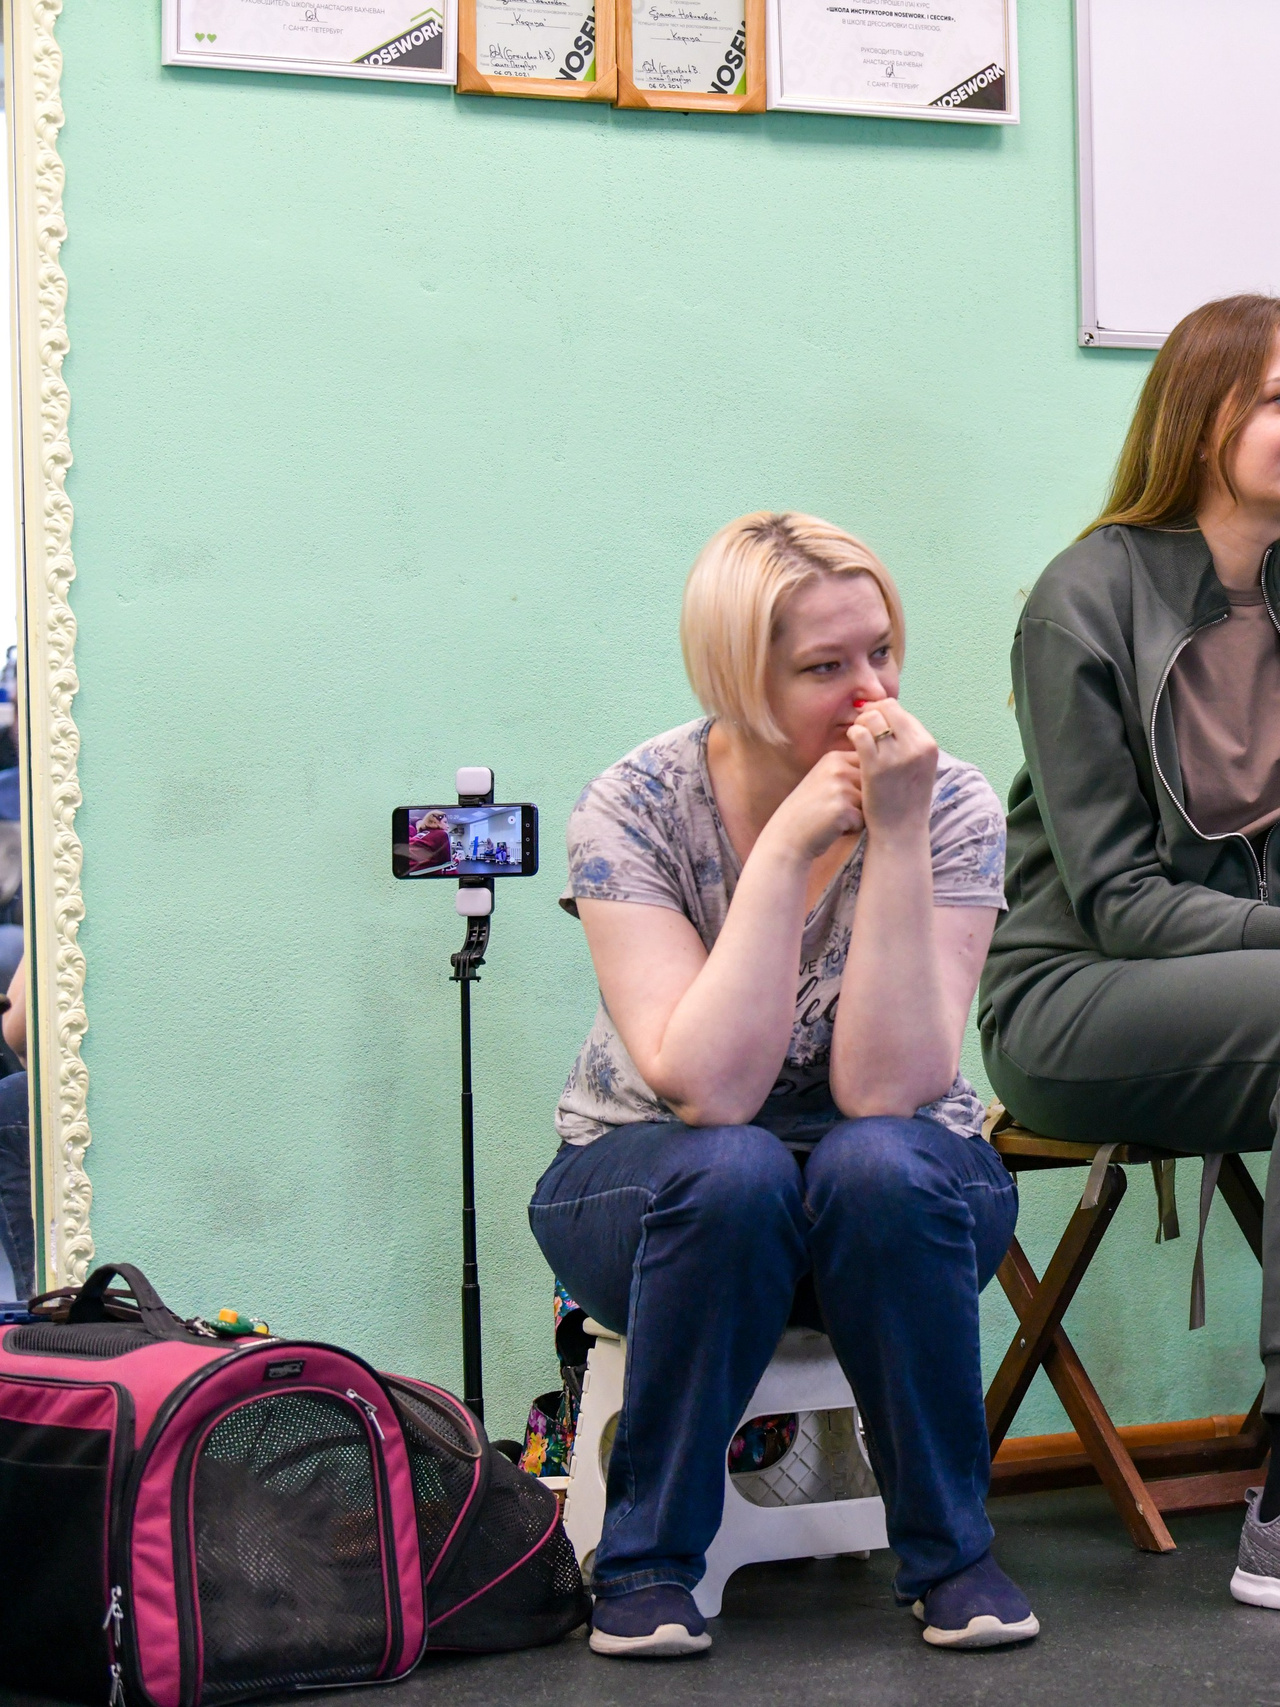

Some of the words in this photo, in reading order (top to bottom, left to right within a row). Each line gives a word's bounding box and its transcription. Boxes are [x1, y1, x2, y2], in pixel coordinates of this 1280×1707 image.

[316, 3, 353, 12] АНАСТАСИЯ
[354, 6, 385, 14] БАХЧЕВАН
[850, 8, 893, 17] ИНСТРУКТОРОВ
[867, 20, 908, 29] ДРЕССИРОВКИ
[289, 25, 343, 34] САНКТ-ПЕТЕРБУРГ
[860, 47, 902, 56] РУКОВОДИТЕЛЬ
[862, 58, 895, 66] АНАСТАСИЯ
[872, 81, 919, 90] САНКТ-ПЕТЕРБУРГ
[822, 948, 841, 968] TO
